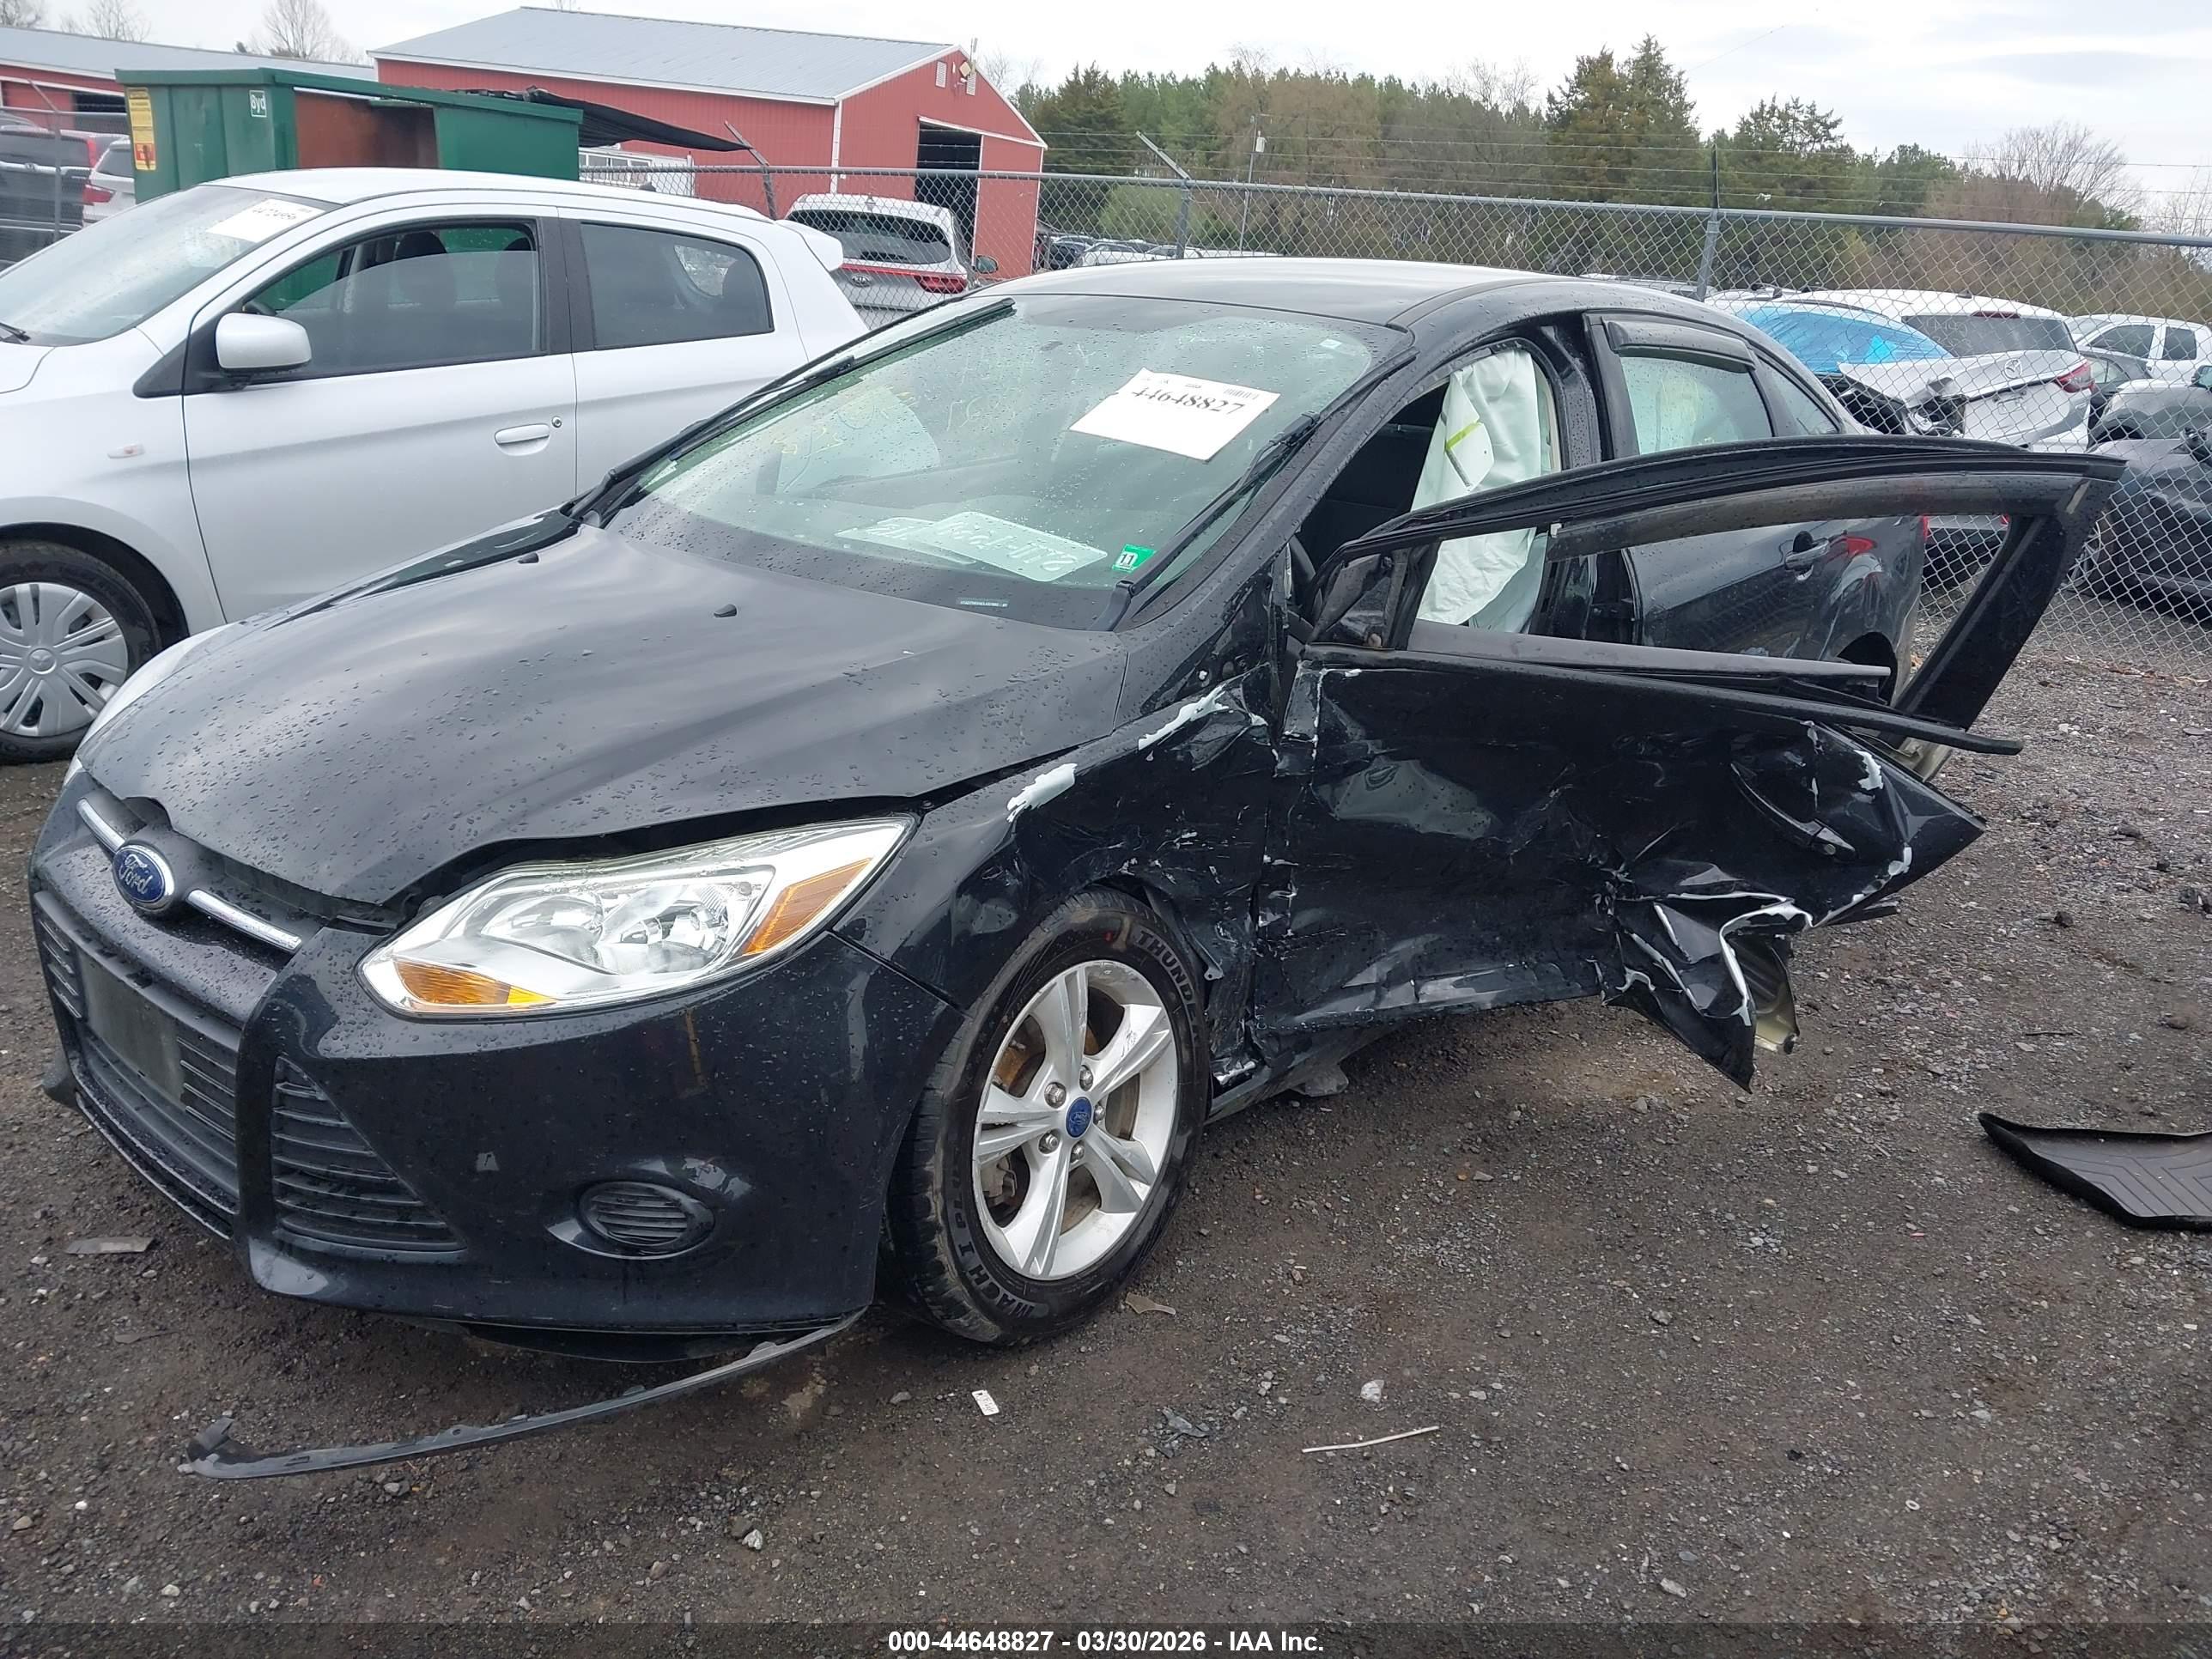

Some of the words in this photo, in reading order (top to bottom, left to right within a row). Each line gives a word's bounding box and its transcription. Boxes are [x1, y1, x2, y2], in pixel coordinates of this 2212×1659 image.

[1131, 386, 1246, 415] 44648827
[1119, 553, 1135, 566] 11
[118, 853, 154, 895] Ford
[968, 1264, 1035, 1319] MACH
